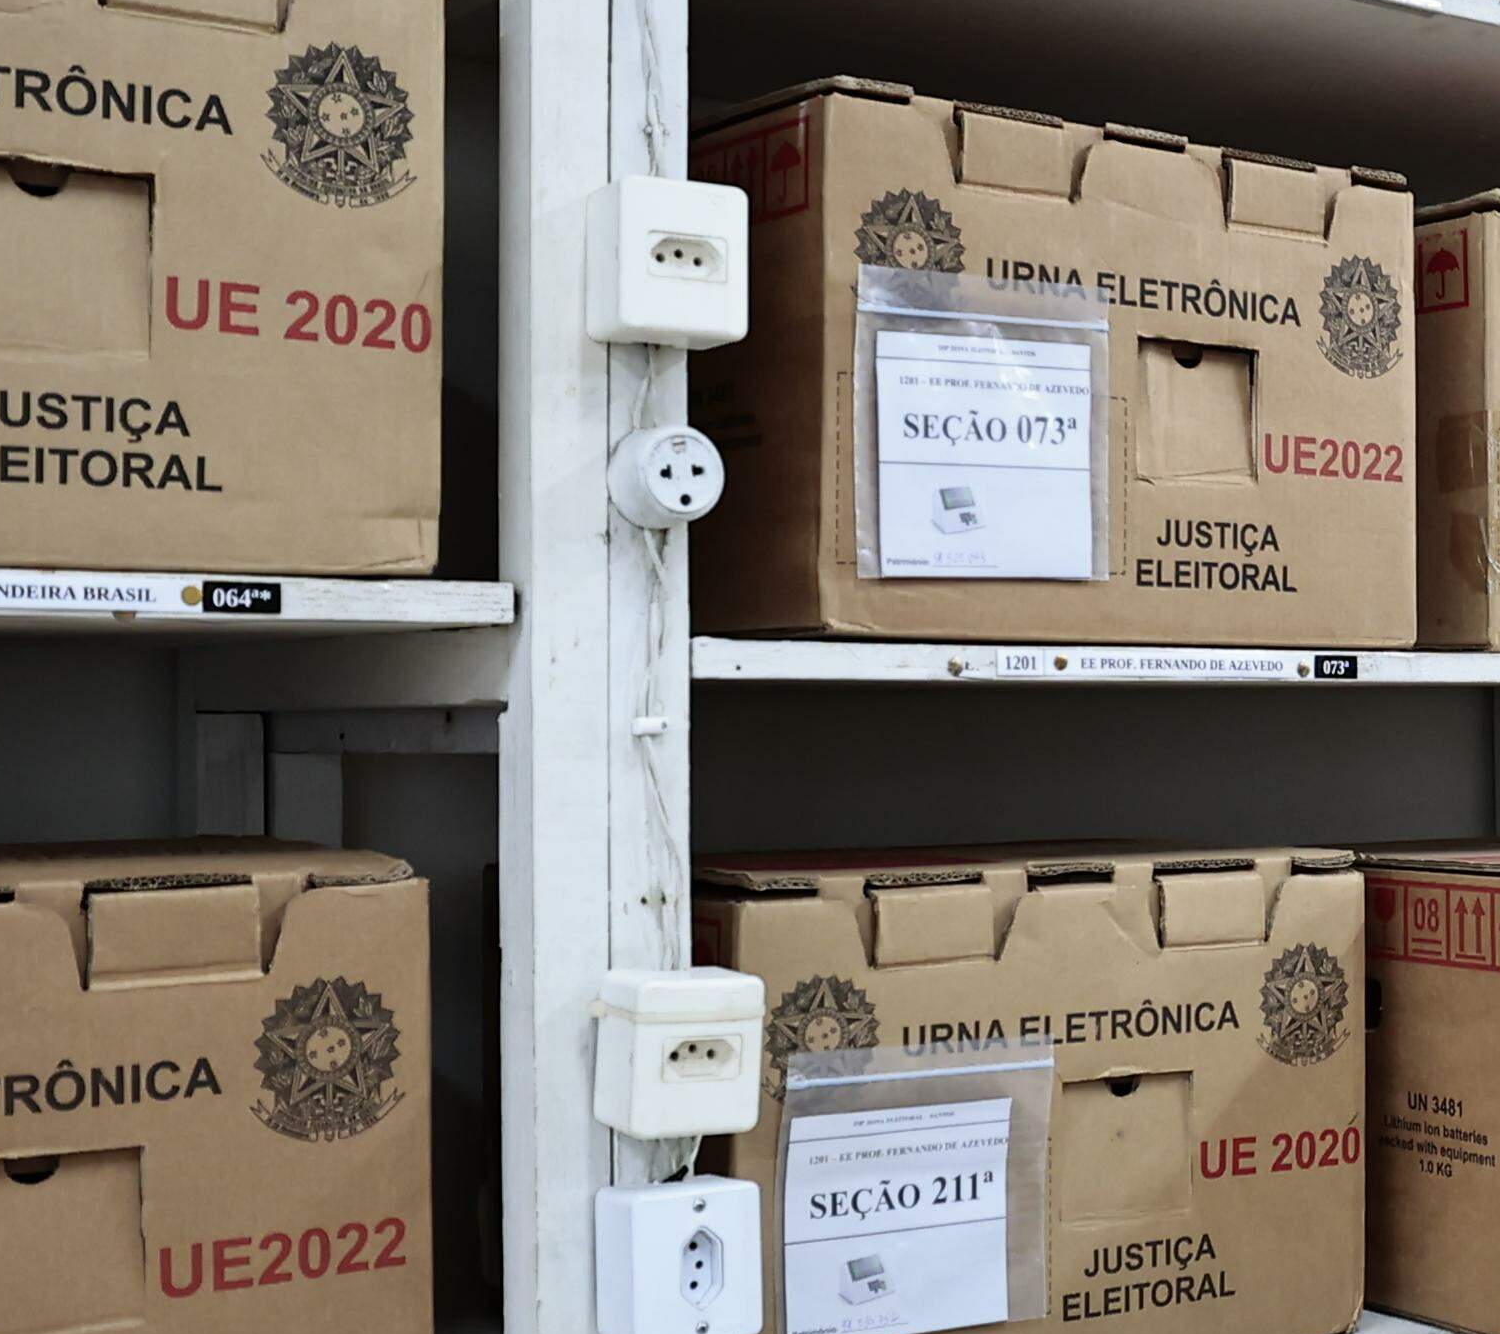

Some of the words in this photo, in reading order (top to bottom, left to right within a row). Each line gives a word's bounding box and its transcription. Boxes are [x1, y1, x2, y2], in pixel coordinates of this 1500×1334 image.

[986, 258, 1088, 301] URNA
[1096, 273, 1301, 327] ELETRÔNICA
[164, 275, 260, 338] UE
[283, 289, 432, 354] 2020
[903, 411, 1008, 448] SEÇÃO
[1016, 415, 1078, 447] 073ª
[1264, 435, 1404, 483] UE2022
[84, 585, 158, 604] BRASIL
[1004, 655, 1038, 671] 1201
[1322, 658, 1350, 676] 073ª
[1413, 899, 1440, 932] 08
[903, 1023, 1008, 1057] URNA
[1019, 999, 1239, 1047] ELETRÔNICA
[1408, 1092, 1427, 1111] UN
[1432, 1096, 1463, 1117] 3481
[1201, 1139, 1256, 1179] UE
[1271, 1126, 1360, 1172] 2020
[1417, 1141, 1437, 1154] with
[1441, 1146, 1495, 1167] equipment
[1443, 1125, 1488, 1145] batteries
[1420, 1159, 1433, 1173] 1.0
[1437, 1162, 1452, 1178] KG
[808, 1183, 921, 1223] SEÇÃO
[931, 1170, 994, 1206] 211ª
[158, 1217, 408, 1300] UE2022
[1083, 1233, 1216, 1276] JUSTIÇA
[1062, 1270, 1236, 1321] ELEITORAL
